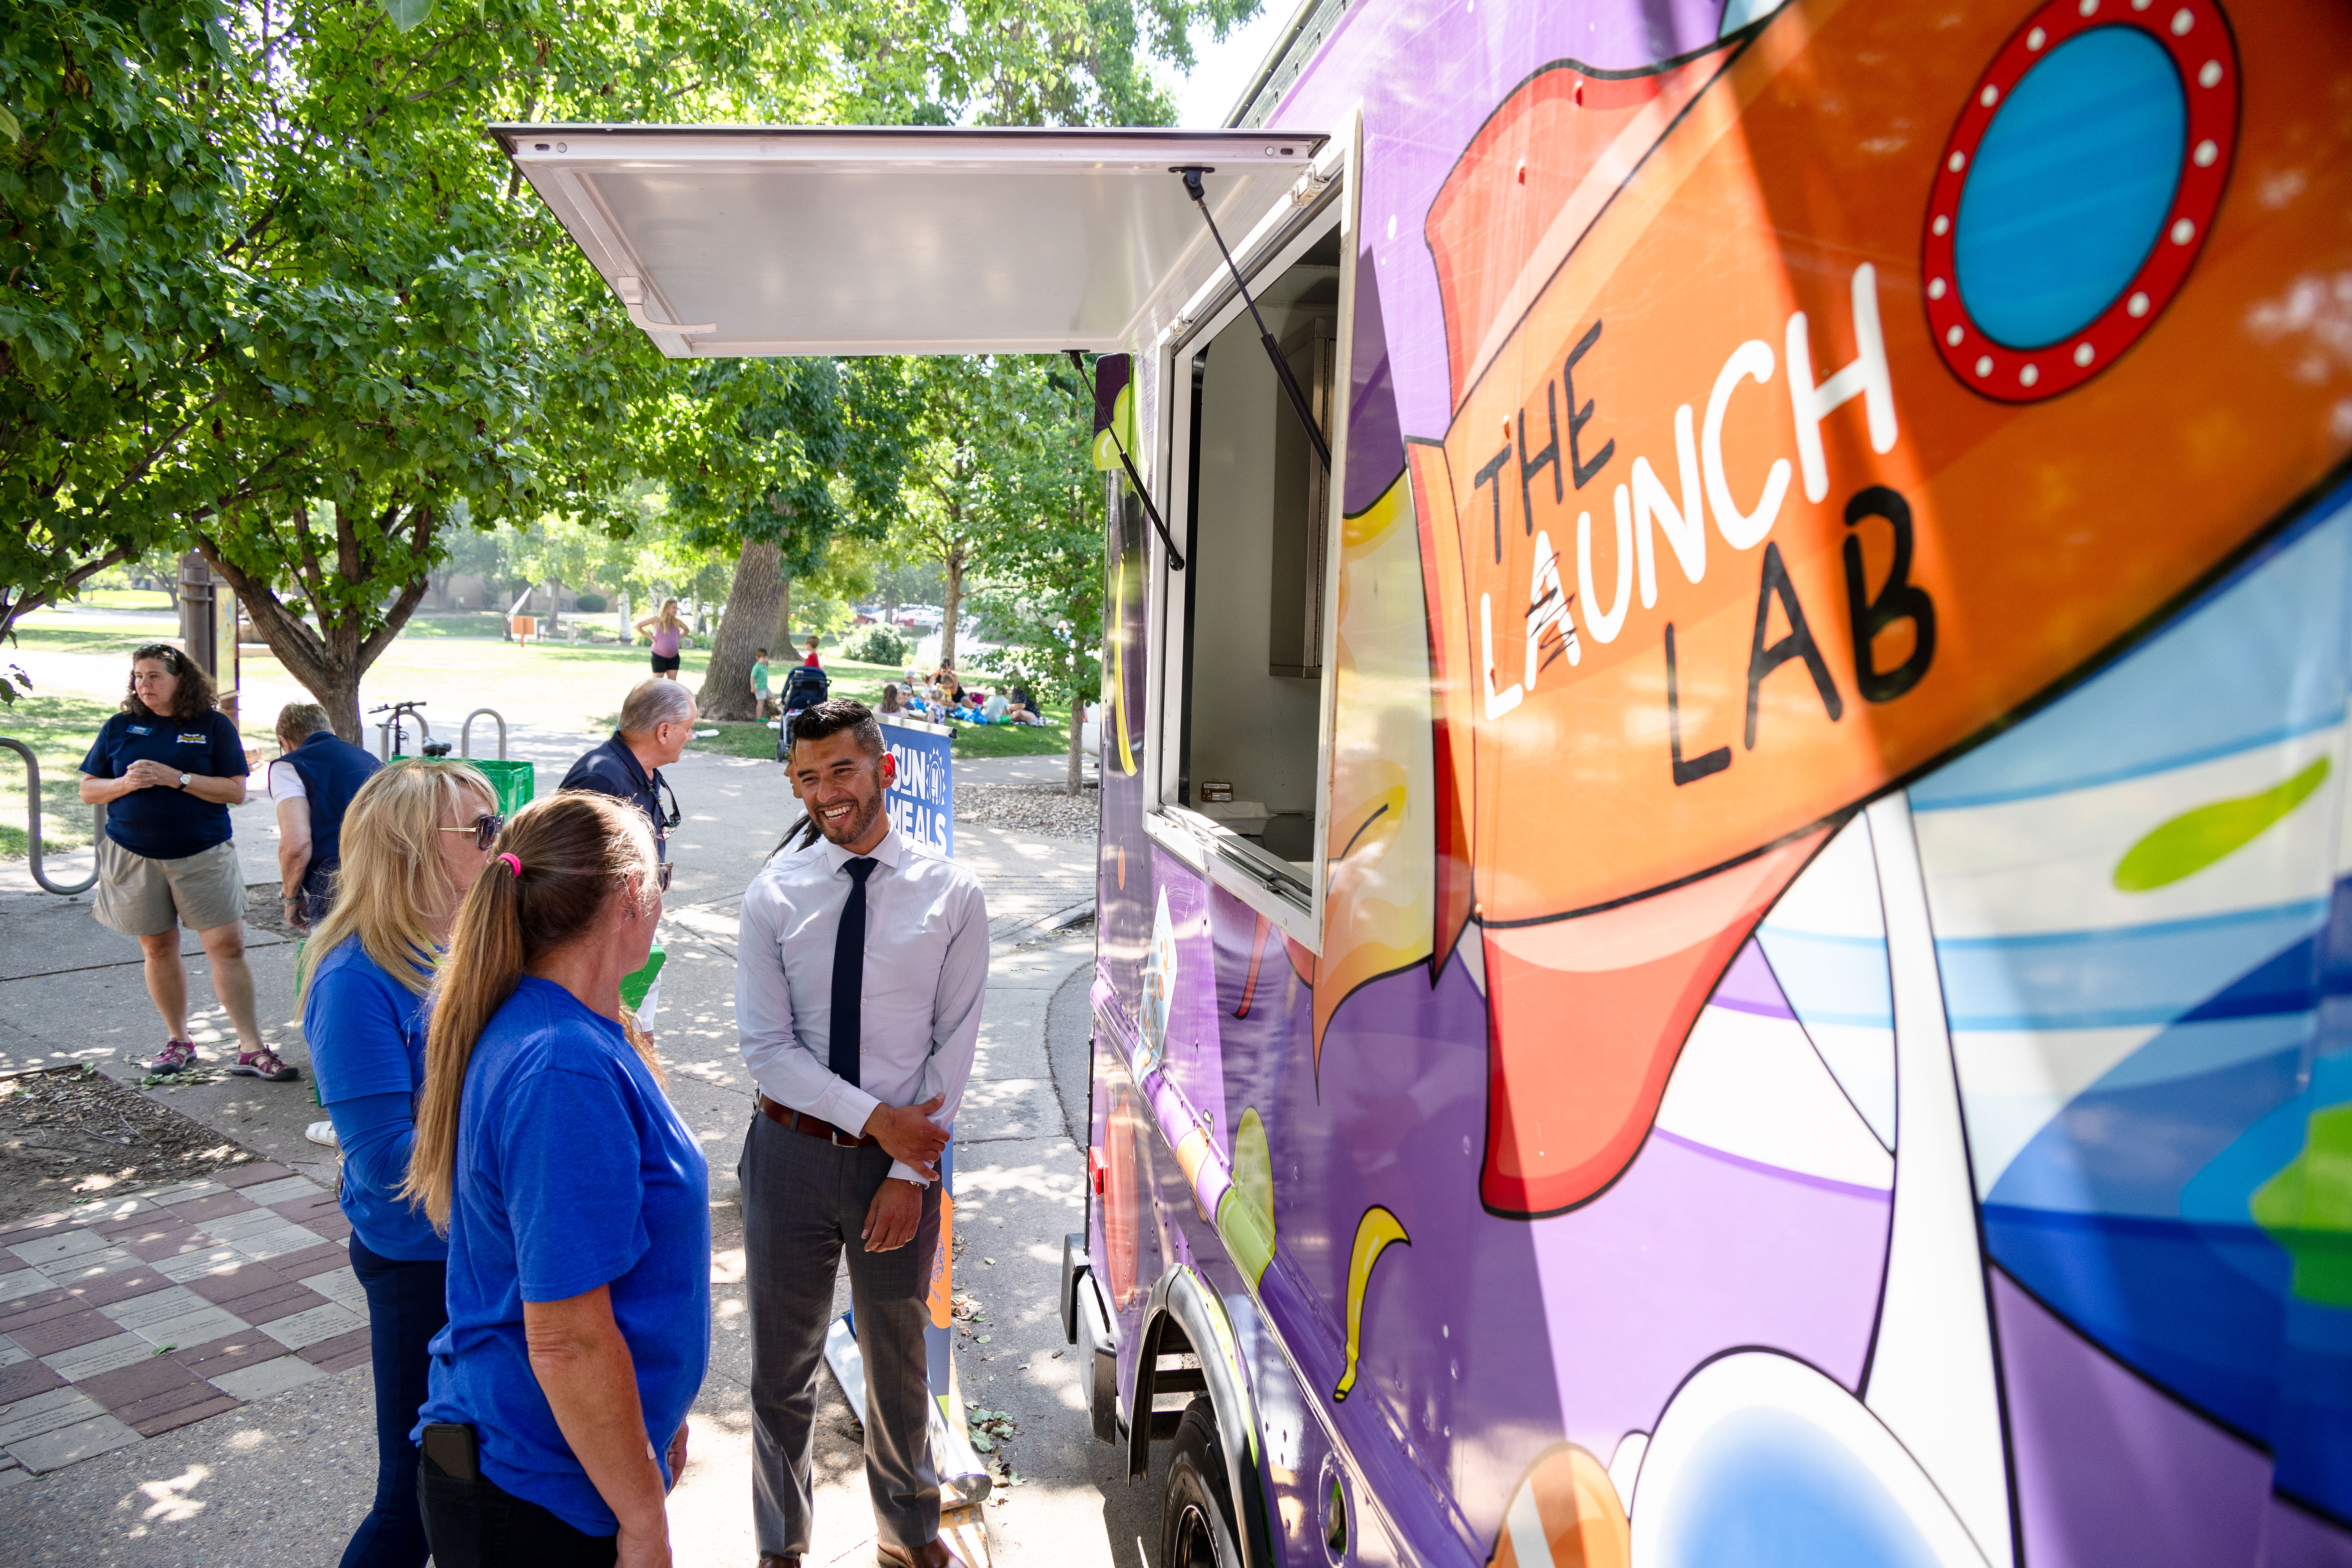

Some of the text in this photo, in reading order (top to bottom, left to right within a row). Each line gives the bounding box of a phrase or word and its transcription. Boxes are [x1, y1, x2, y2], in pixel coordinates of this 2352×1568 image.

[1475, 319, 1615, 564] THE
[1480, 261, 1898, 720] LAUNCH
[1665, 485, 1936, 786] LAB
[890, 796, 947, 855] MEALS
[891, 744, 926, 800] SUN
